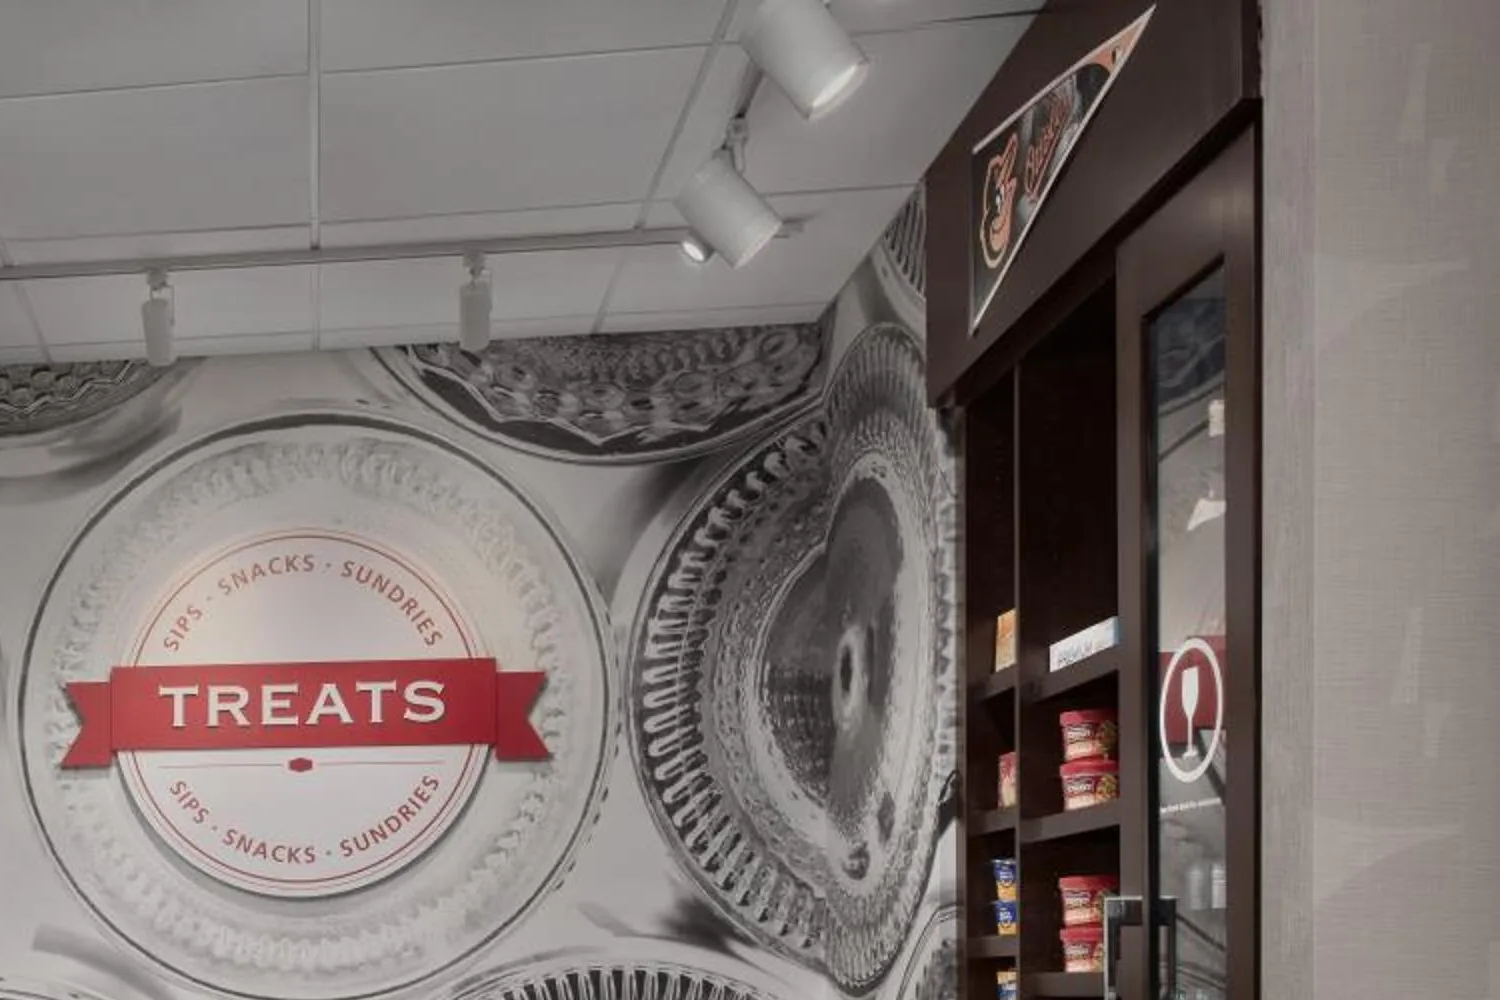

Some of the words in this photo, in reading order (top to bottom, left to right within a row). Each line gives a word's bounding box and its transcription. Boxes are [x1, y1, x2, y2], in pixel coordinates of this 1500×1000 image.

[164, 604, 203, 651] SIPS
[218, 554, 316, 596] SNACKS
[341, 559, 443, 647] SUNDRIES
[158, 680, 446, 729] TREATS
[169, 780, 211, 825] SIPS
[222, 828, 316, 865] SNACKS
[339, 774, 440, 858] SUNDRIES
